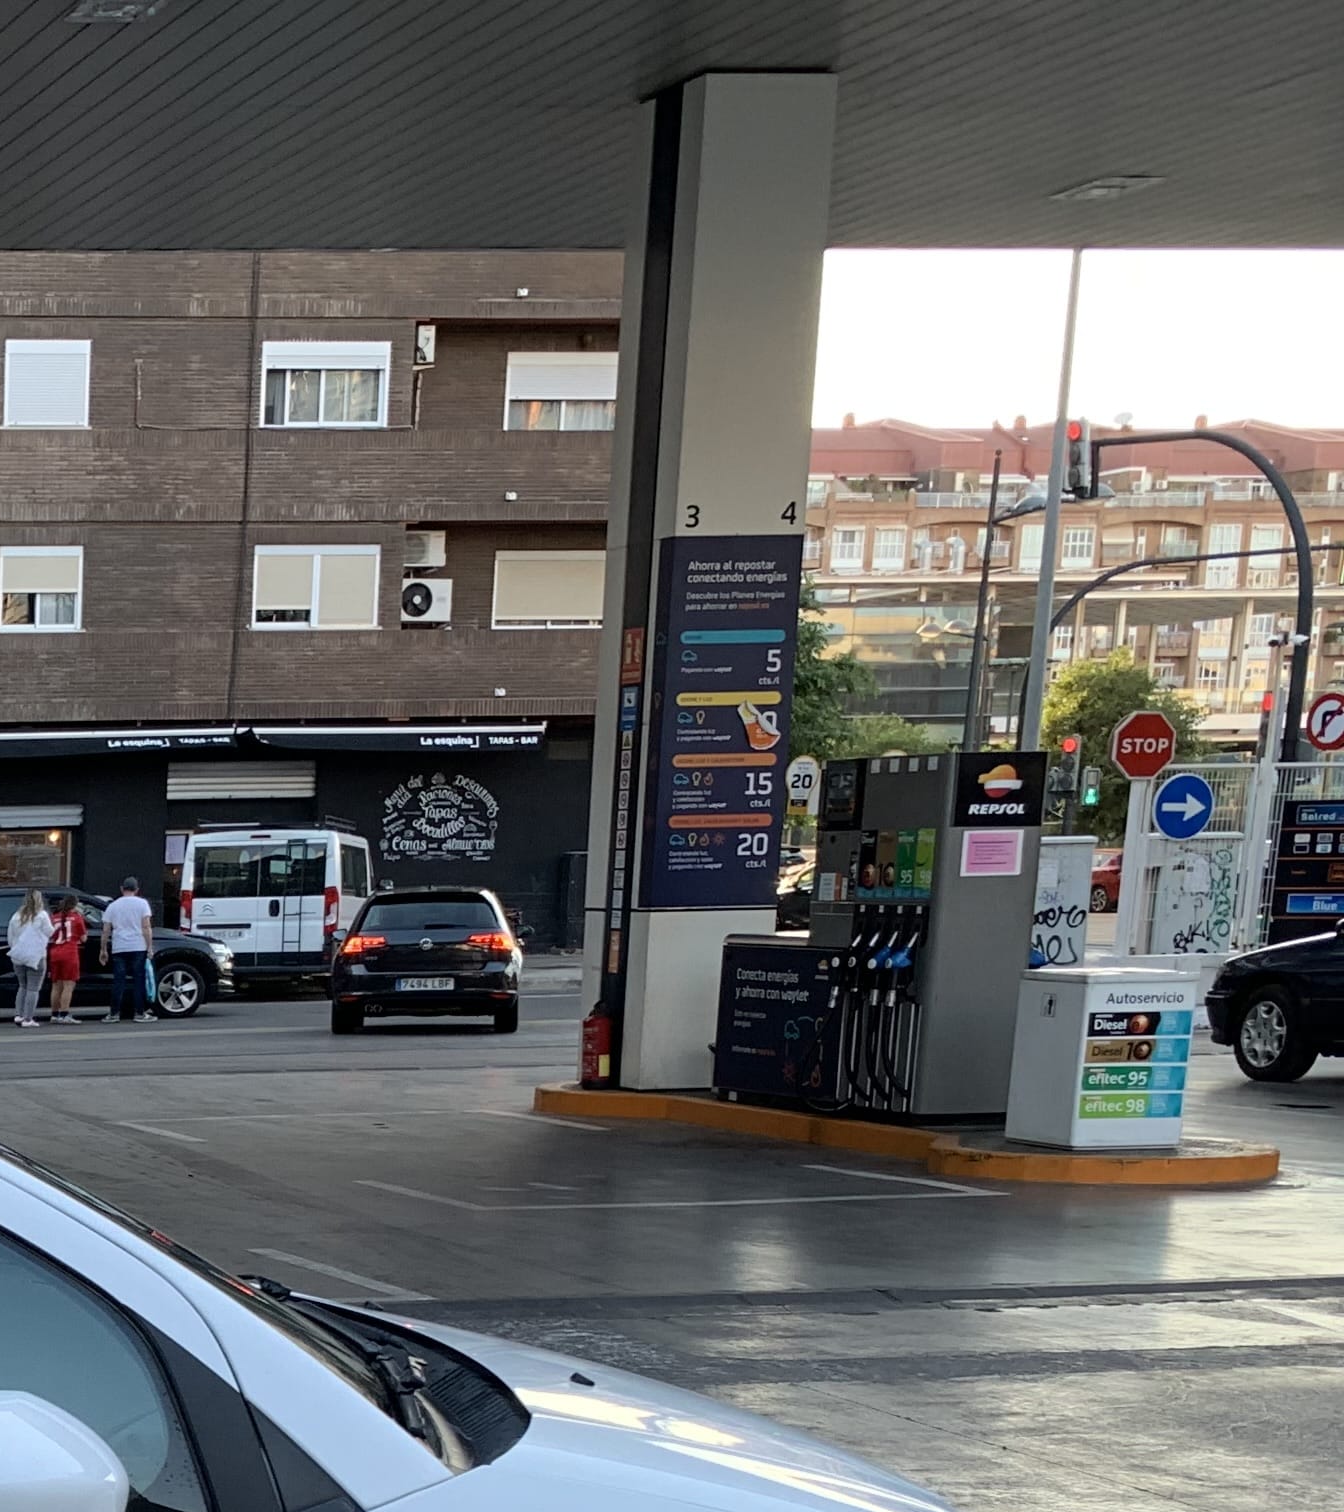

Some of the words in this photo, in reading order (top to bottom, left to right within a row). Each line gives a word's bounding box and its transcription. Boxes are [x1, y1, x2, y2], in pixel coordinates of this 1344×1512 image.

[685, 504, 700, 528] 3
[780, 501, 797, 525] 4
[687, 560, 720, 571] Ahorra
[722, 560, 732, 571] al
[734, 560, 776, 572] repostar
[687, 572, 744, 583] conectando
[745, 571, 788, 584] energías
[765, 649, 782, 673] 5
[123, 738, 164, 748] esquina
[419, 736, 433, 746] La
[434, 735, 474, 747] esquina
[488, 736, 514, 745] TAPAS
[520, 736, 538, 745] BAR
[1120, 737, 1169, 754] STOP
[744, 772, 773, 796] 15
[791, 773, 813, 789] 20
[967, 803, 1025, 816] REPSOL
[736, 832, 769, 857] 20
[1312, 900, 1339, 912] Blue
[736, 967, 767, 981] Conecta
[735, 986, 741, 1000] y
[766, 988, 781, 1000] con
[1106, 991, 1185, 1005] Autoservicio
[1093, 1018, 1128, 1031] Diesel
[1092, 1045, 1123, 1057] Diesel
[1126, 1040, 1153, 1061] 10
[1088, 1071, 1126, 1085] efitec
[1127, 1071, 1149, 1086] 95
[1085, 1100, 1123, 1113] efitec
[1125, 1098, 1146, 1113] 98
